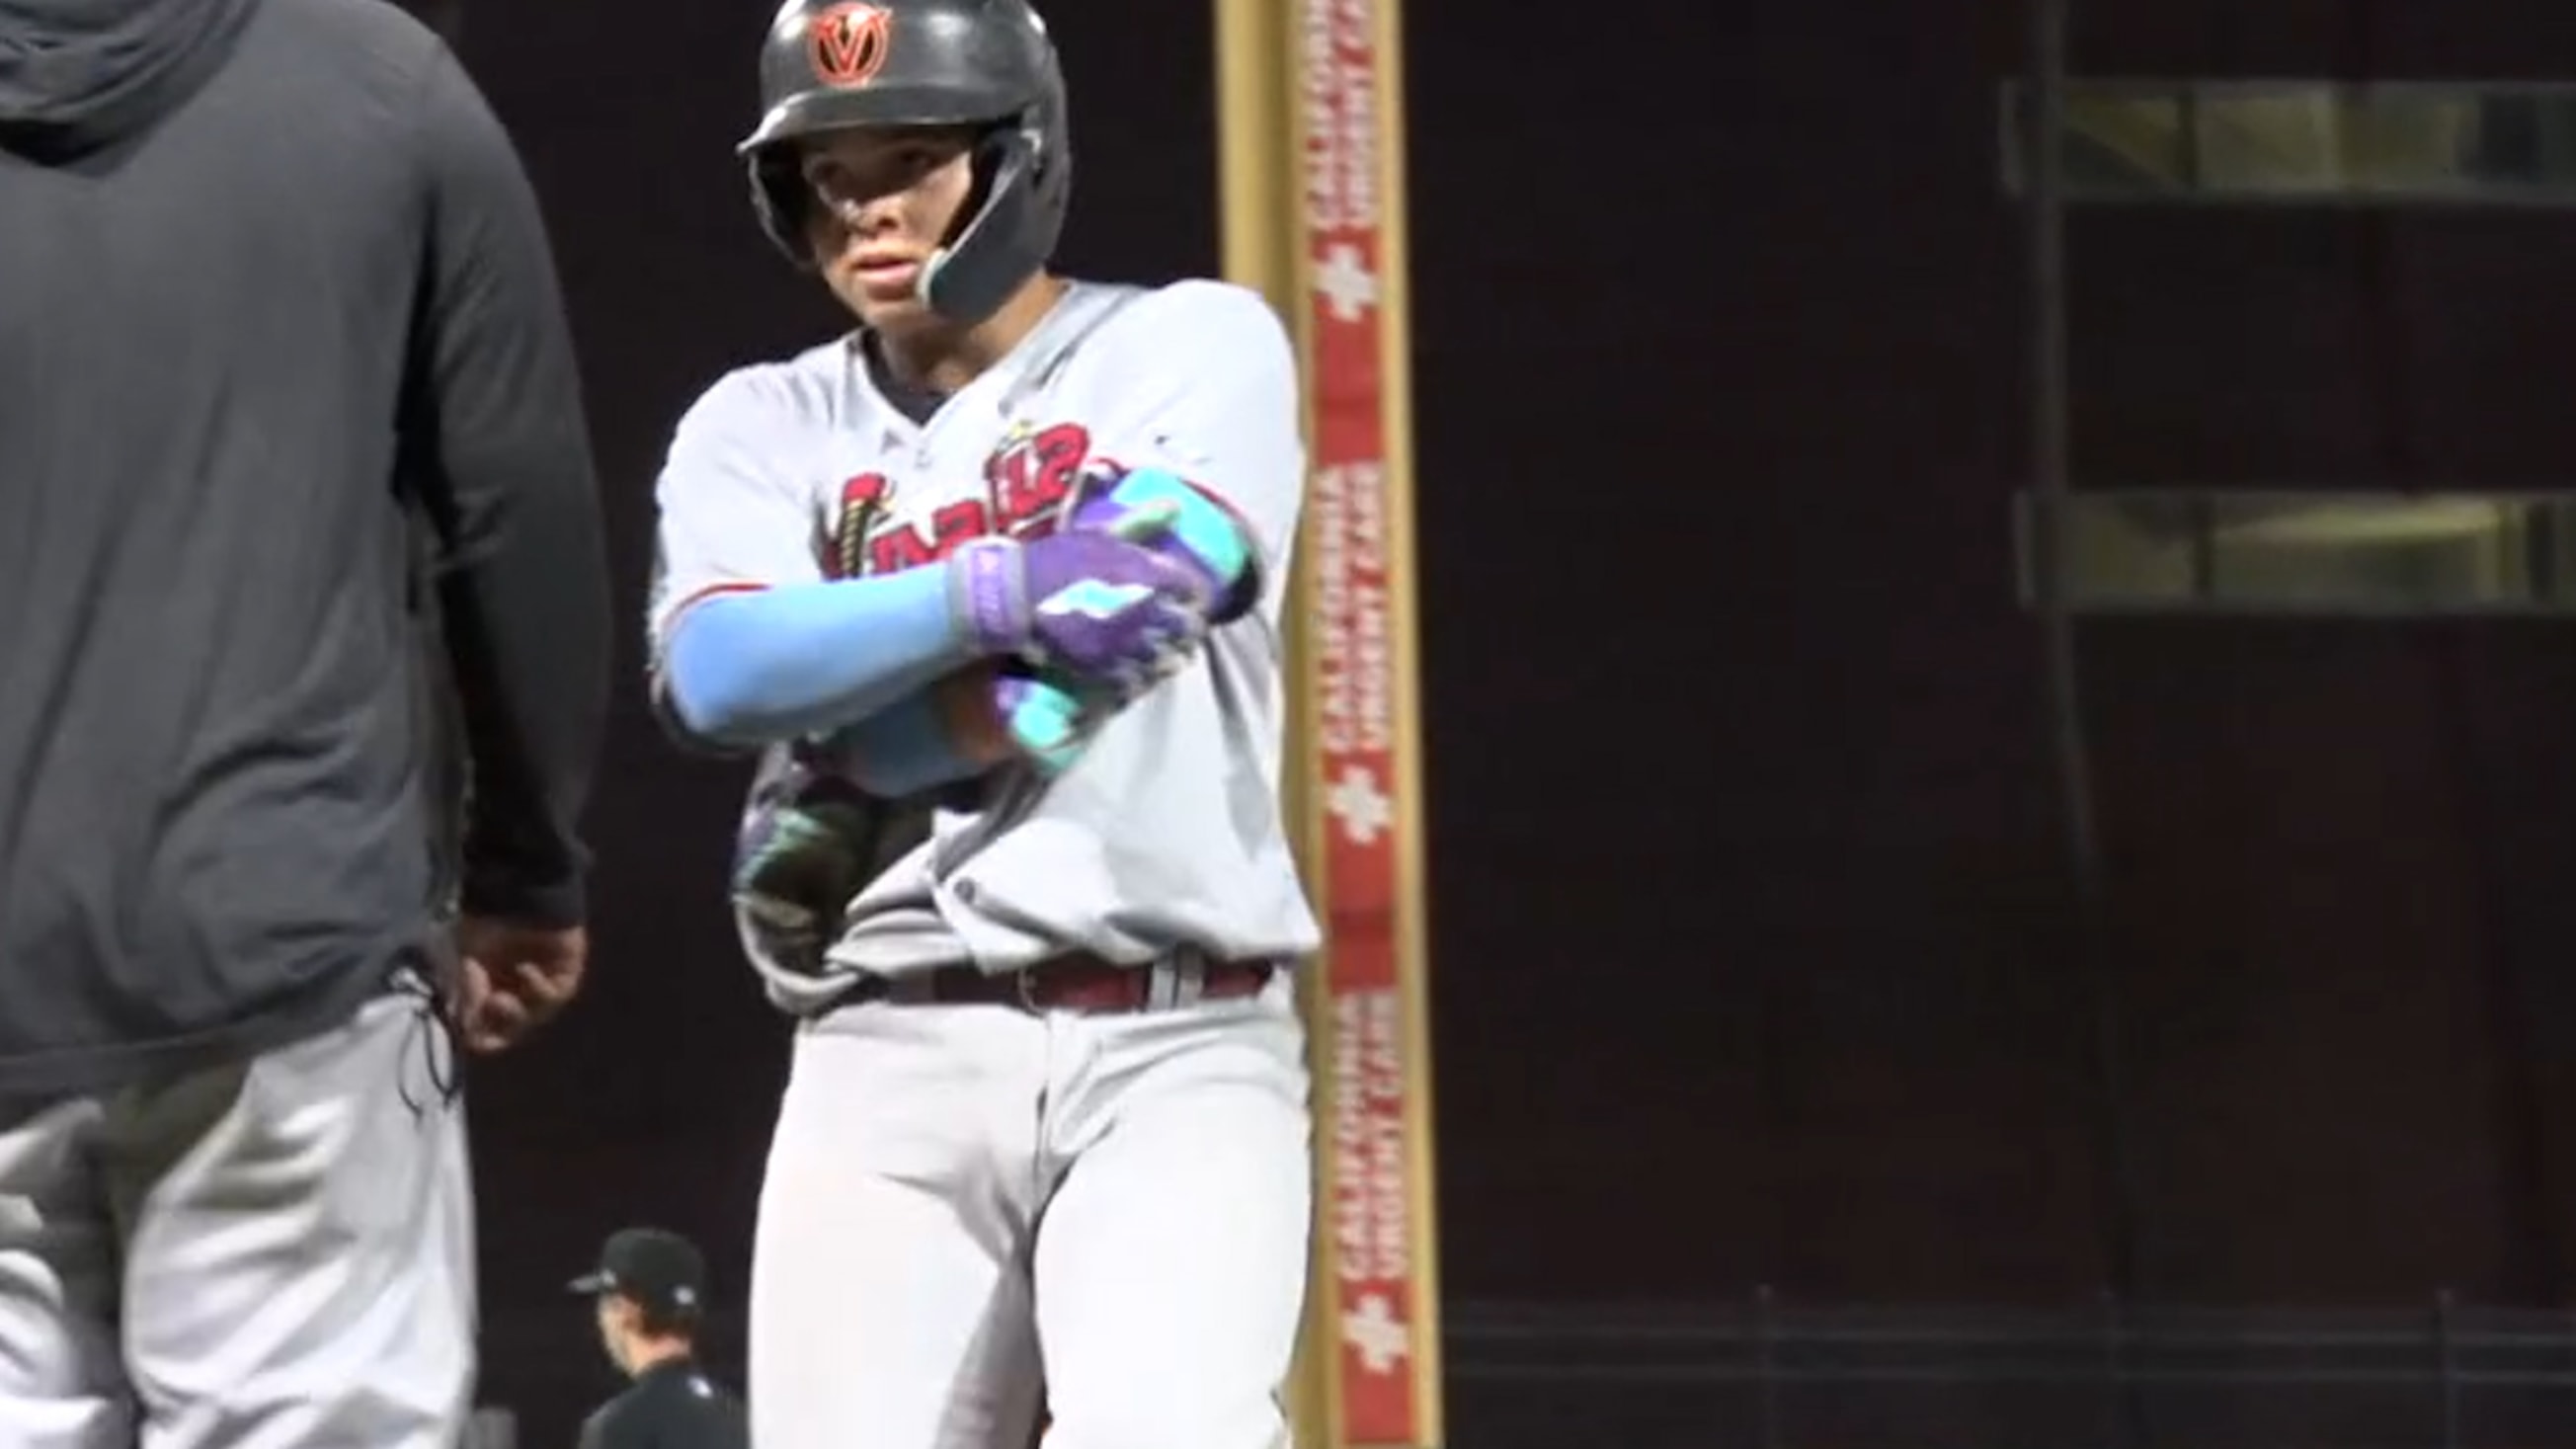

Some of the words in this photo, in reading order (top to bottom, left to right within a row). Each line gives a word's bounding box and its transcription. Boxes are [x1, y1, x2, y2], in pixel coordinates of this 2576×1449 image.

[1340, 64, 1374, 229] URGENT
[1351, 461, 1385, 571] CARE
[1318, 466, 1351, 753] CALIFORNIA
[1354, 585, 1389, 751] URGENT
[1368, 992, 1401, 1098] CARE
[1334, 994, 1366, 1281] CALIFORNIA
[1371, 1114, 1407, 1281] URGENT
